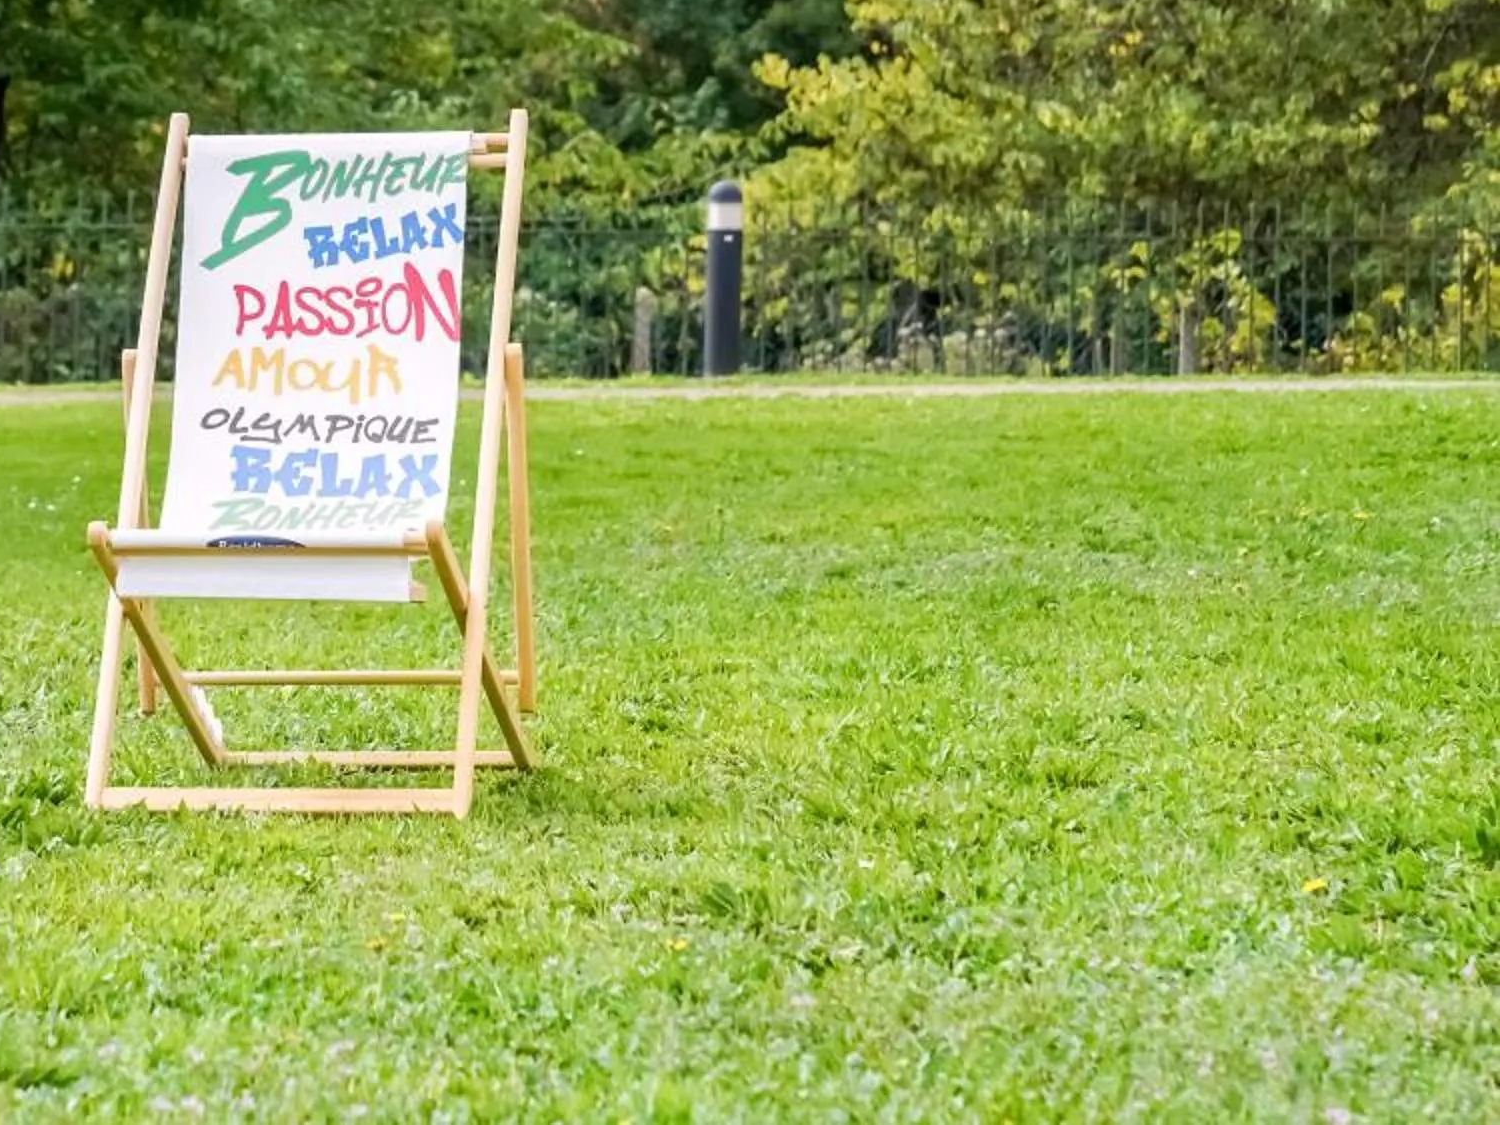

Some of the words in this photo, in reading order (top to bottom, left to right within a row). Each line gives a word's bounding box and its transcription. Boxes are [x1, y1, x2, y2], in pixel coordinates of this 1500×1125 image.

[200, 150, 468, 270] BONHEUR
[304, 203, 463, 268] RELAX
[212, 344, 404, 405] AMOUR
[230, 445, 441, 499] RELAX
[208, 497, 424, 531] BONHEUR
